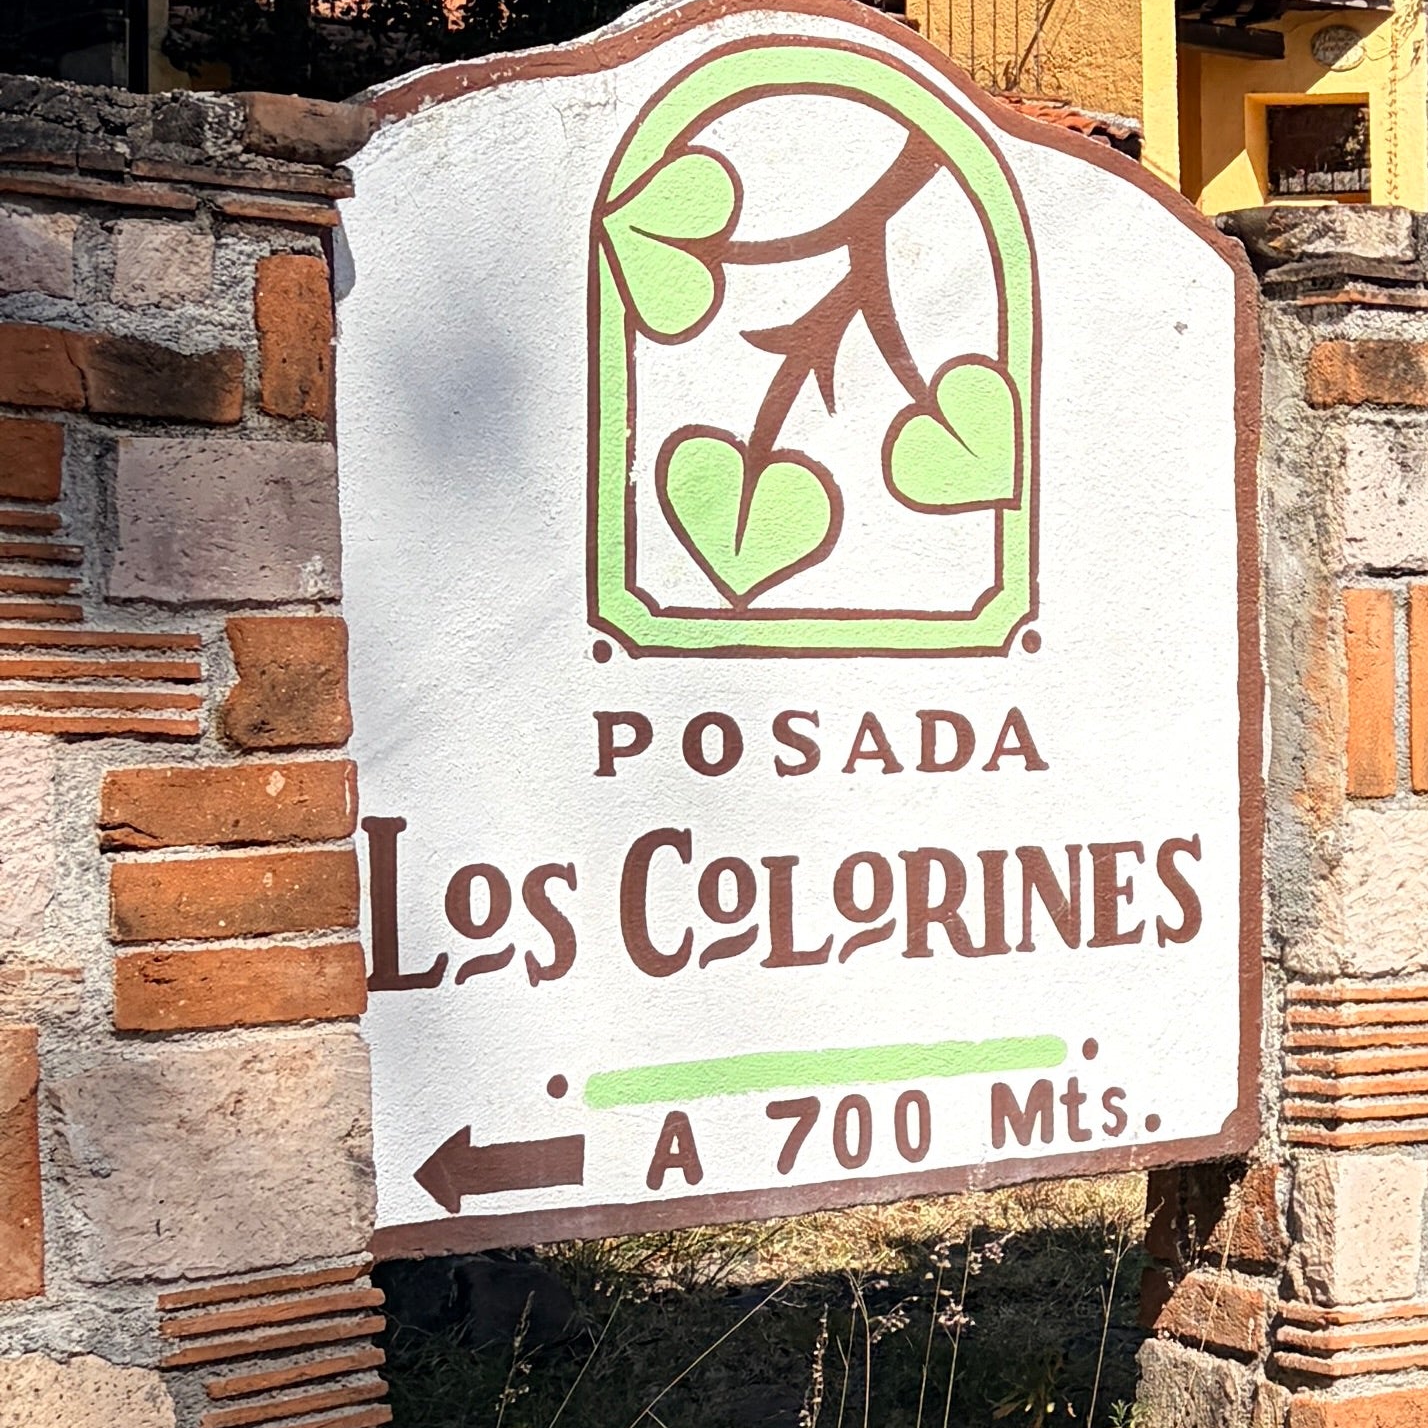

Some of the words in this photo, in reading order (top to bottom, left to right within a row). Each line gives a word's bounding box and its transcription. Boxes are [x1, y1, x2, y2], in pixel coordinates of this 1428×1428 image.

[592, 707, 1049, 778] POSADA
[645, 1109, 705, 1192] A
[765, 1088, 932, 1176] 700
[990, 1076, 1163, 1149] Mts.
